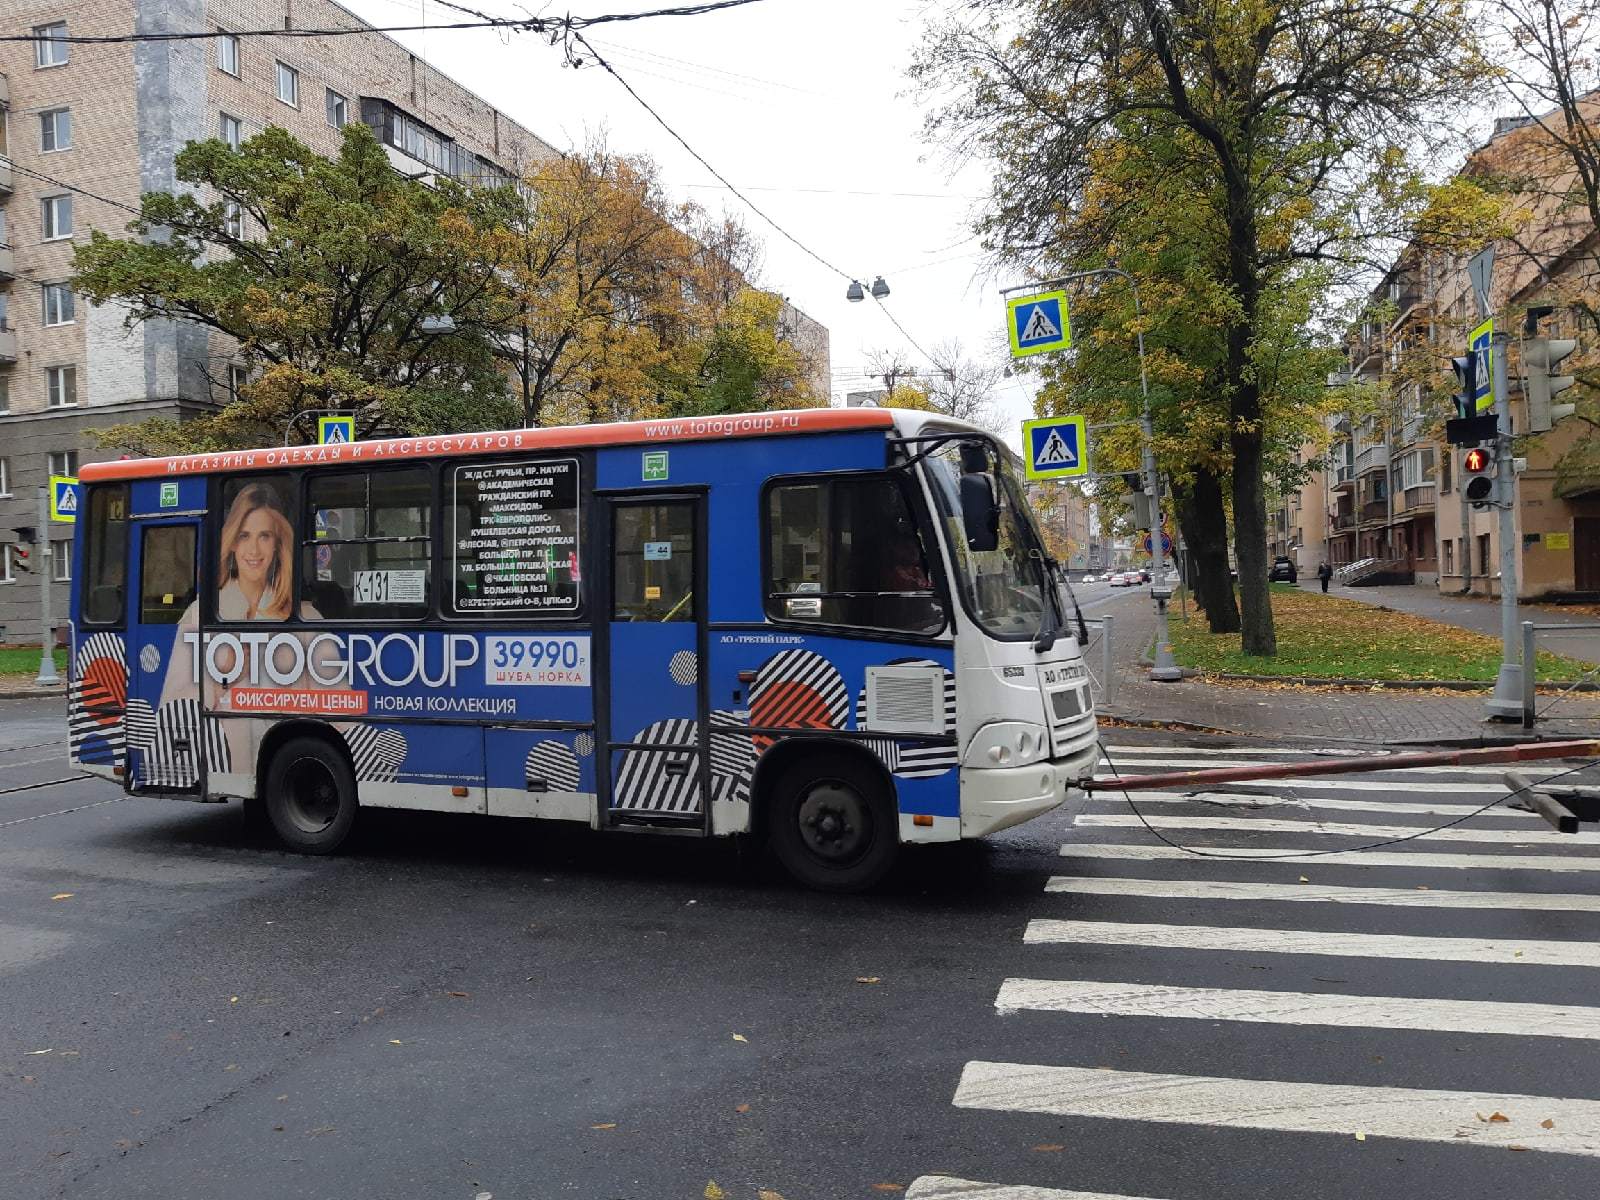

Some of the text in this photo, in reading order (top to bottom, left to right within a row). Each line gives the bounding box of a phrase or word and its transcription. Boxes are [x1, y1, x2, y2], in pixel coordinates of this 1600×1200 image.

[645, 416, 799, 436] www.totogroup.ru
[167, 435, 523, 473] МАГАЗИНЫ ОДЕЖДЫ И АКСЕССУАРОВ
[526, 467, 539, 475] ПР.
[540, 465, 568, 474] НАУКИ
[479, 490, 554, 501] ГРАЖДАНСКИЙ ПР.
[471, 525, 561, 536] КУШЕЛЕВСКАЯ ДОРОГА
[480, 549, 520, 559] БОЛЬШОЙ
[461, 564, 474, 572] УЛ.
[475, 562, 515, 571] БОЛЬШАЯ
[356, 572, 388, 601] К-131
[484, 586, 528, 595] БОЛЬНИЦА
[720, 636, 734, 644] АО
[183, 632, 480, 688] TOTOGROUP
[496, 671, 582, 682] ШУБА НОРКА
[236, 691, 363, 711] ФИКСИРУЕМ ЦЕНЫ!
[374, 696, 516, 715] НОВАЯ КОЛЛЕКЦИЯ
